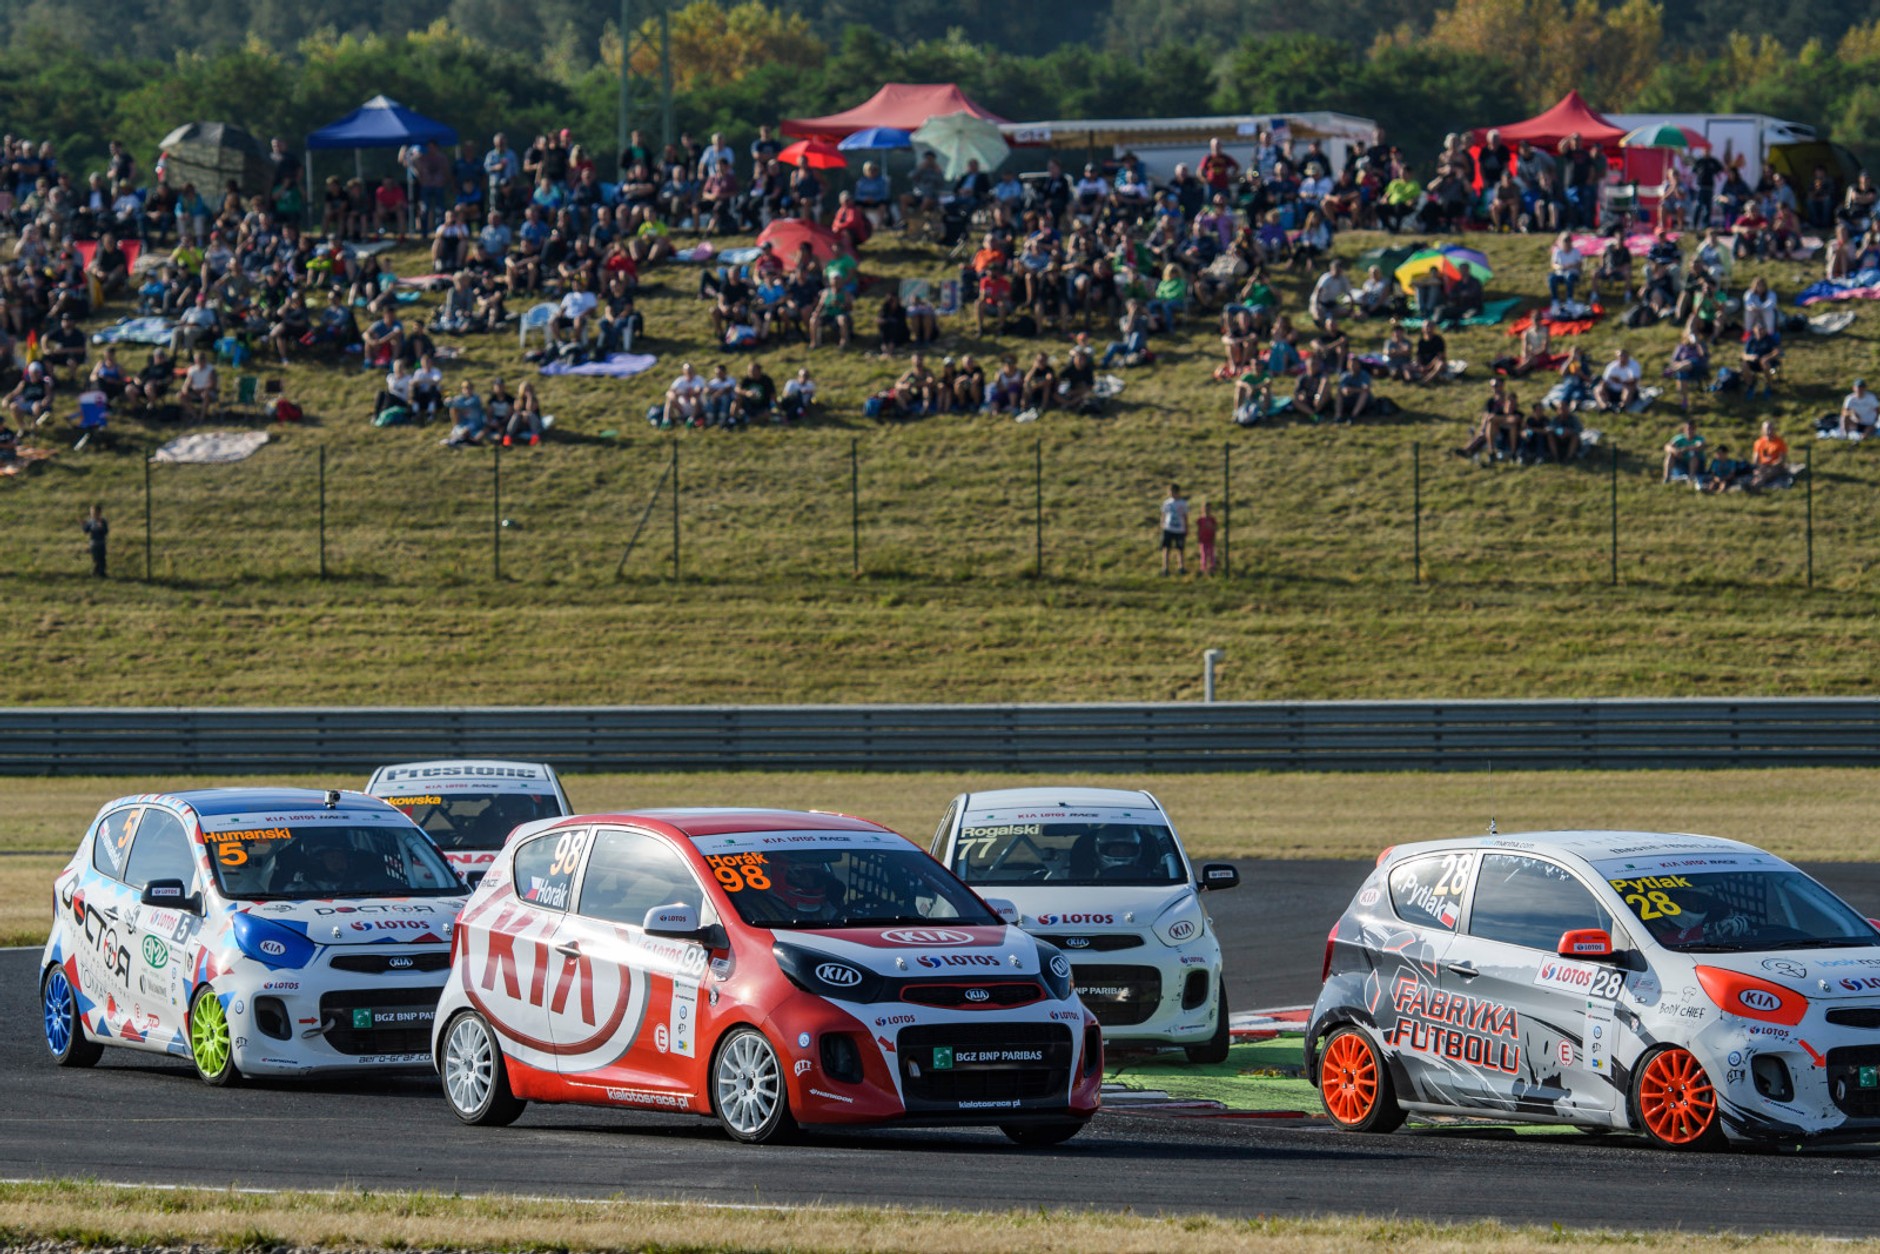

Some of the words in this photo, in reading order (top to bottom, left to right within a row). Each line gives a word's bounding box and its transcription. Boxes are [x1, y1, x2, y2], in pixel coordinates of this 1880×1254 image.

[387, 766, 536, 780] Prestone
[117, 809, 139, 848] 5
[203, 827, 291, 843] Humanski
[961, 824, 1040, 838] Rogalski
[218, 842, 248, 866] 5
[550, 831, 586, 876] 98
[957, 838, 997, 860] 77
[705, 852, 770, 868] Horák
[714, 865, 771, 893] 98
[1433, 854, 1473, 896] 28
[1609, 875, 1693, 893] Pytlak
[536, 879, 568, 907] Horák
[1625, 891, 1682, 921] 28
[374, 920, 430, 930] LOTOS
[1062, 914, 1114, 924] LOTOS
[177, 918, 190, 940] 5
[894, 931, 963, 941] KIA
[1172, 924, 1192, 937] KIA
[262, 942, 281, 953] KIA
[481, 902, 596, 1028] KIA
[683, 947, 706, 976] 98
[941, 955, 1000, 966] LOTOS
[823, 966, 853, 983] KIA
[1556, 966, 1592, 986] LOTOS
[1591, 971, 1622, 998] 28
[969, 990, 986, 999] KIA
[1745, 993, 1774, 1008] KIA
[397, 1012, 417, 1021] BNP
[1395, 976, 1519, 1041] FABRYKA
[888, 1015, 915, 1024] LOTOS
[1762, 1027, 1789, 1036] LOTOS
[1393, 1016, 1520, 1075] FUTBOLU
[979, 1051, 1000, 1060] BNP
[1001, 1050, 1042, 1060] PARIBAS
